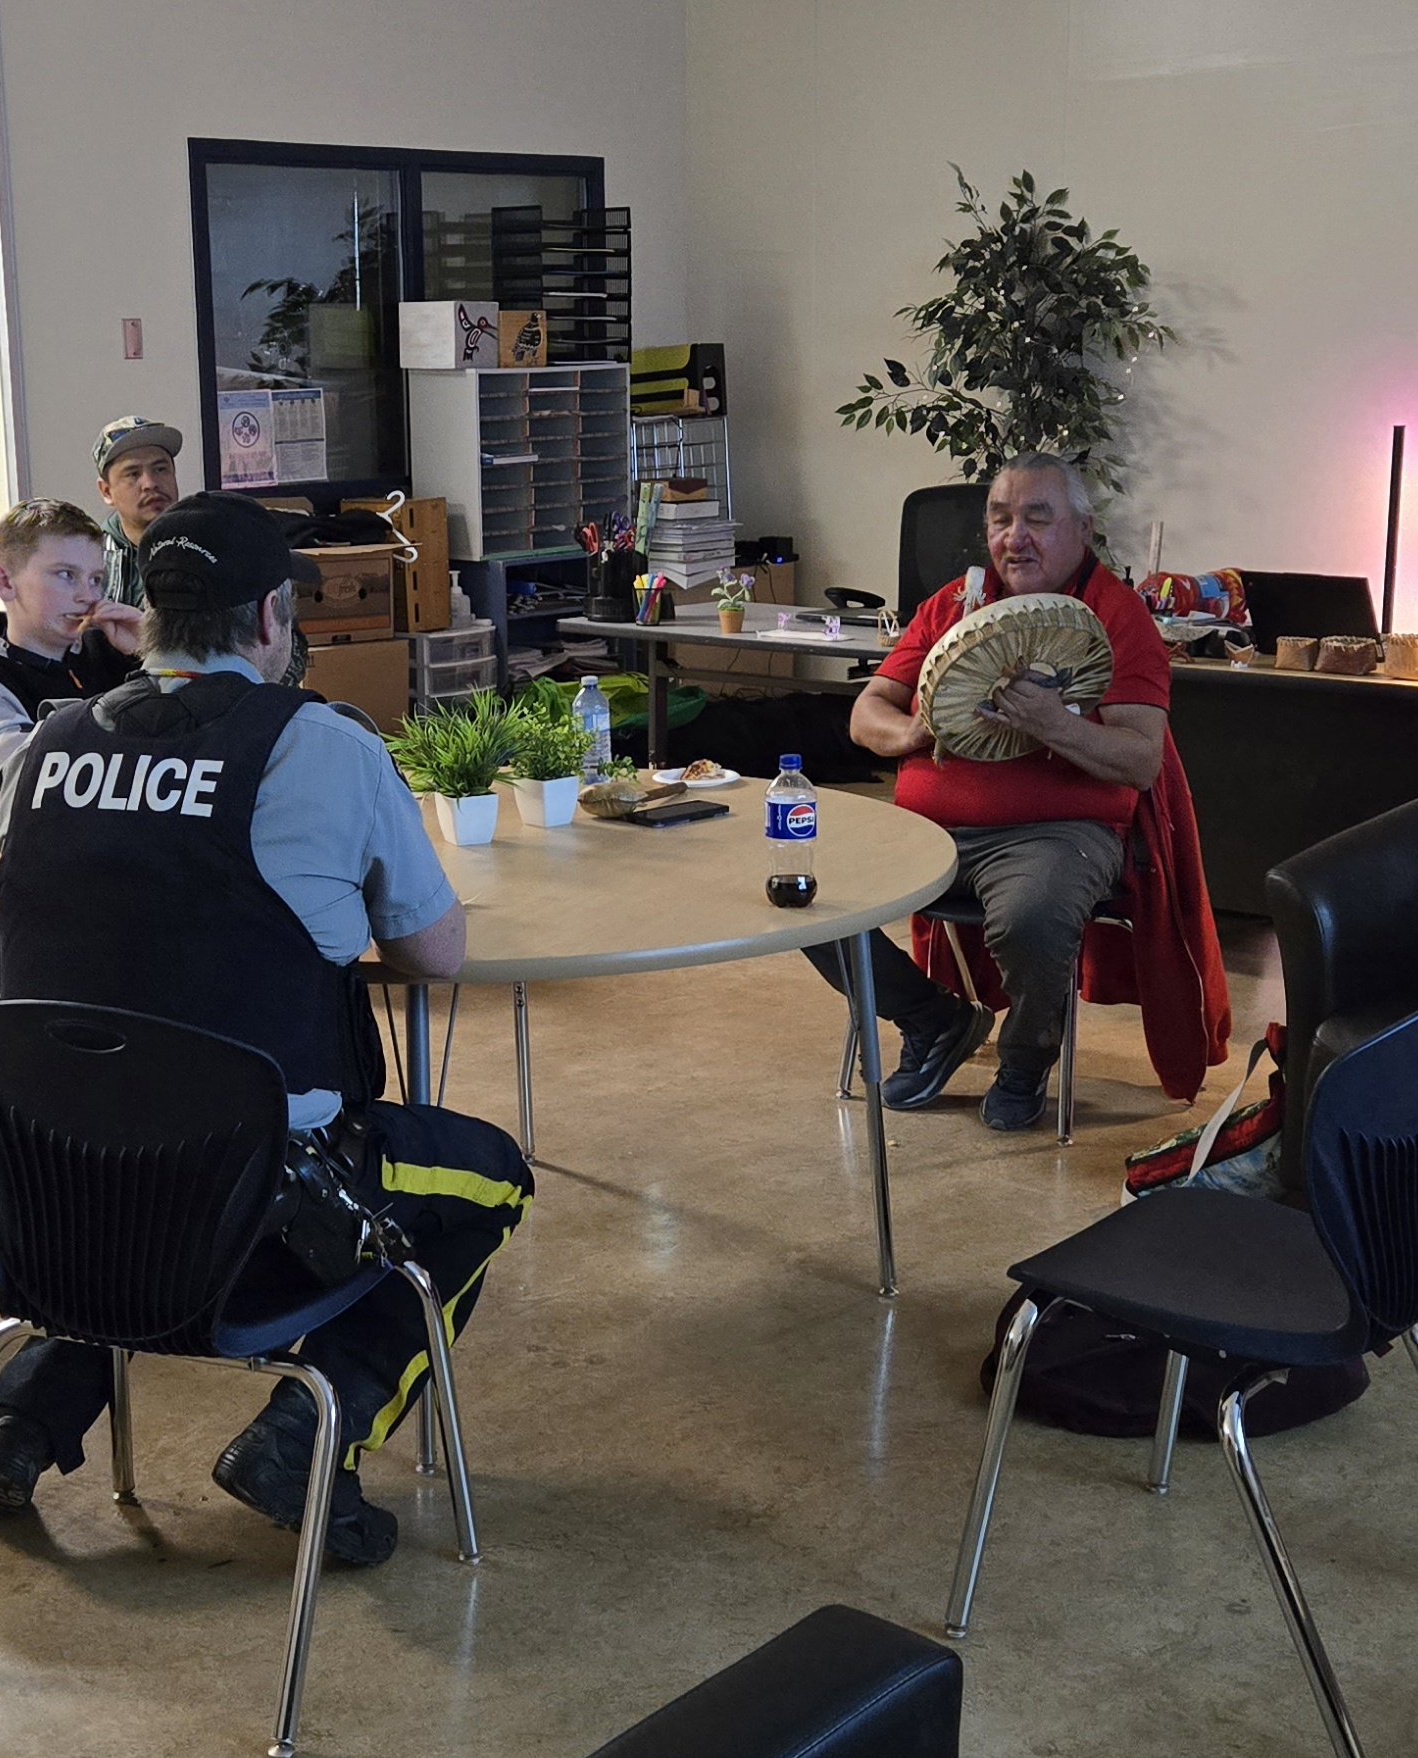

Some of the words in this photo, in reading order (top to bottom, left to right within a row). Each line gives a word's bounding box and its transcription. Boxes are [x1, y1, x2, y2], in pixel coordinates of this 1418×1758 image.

[149, 536, 177, 561] Natural
[176, 536, 218, 564] Resources
[31, 752, 224, 817] POLICE
